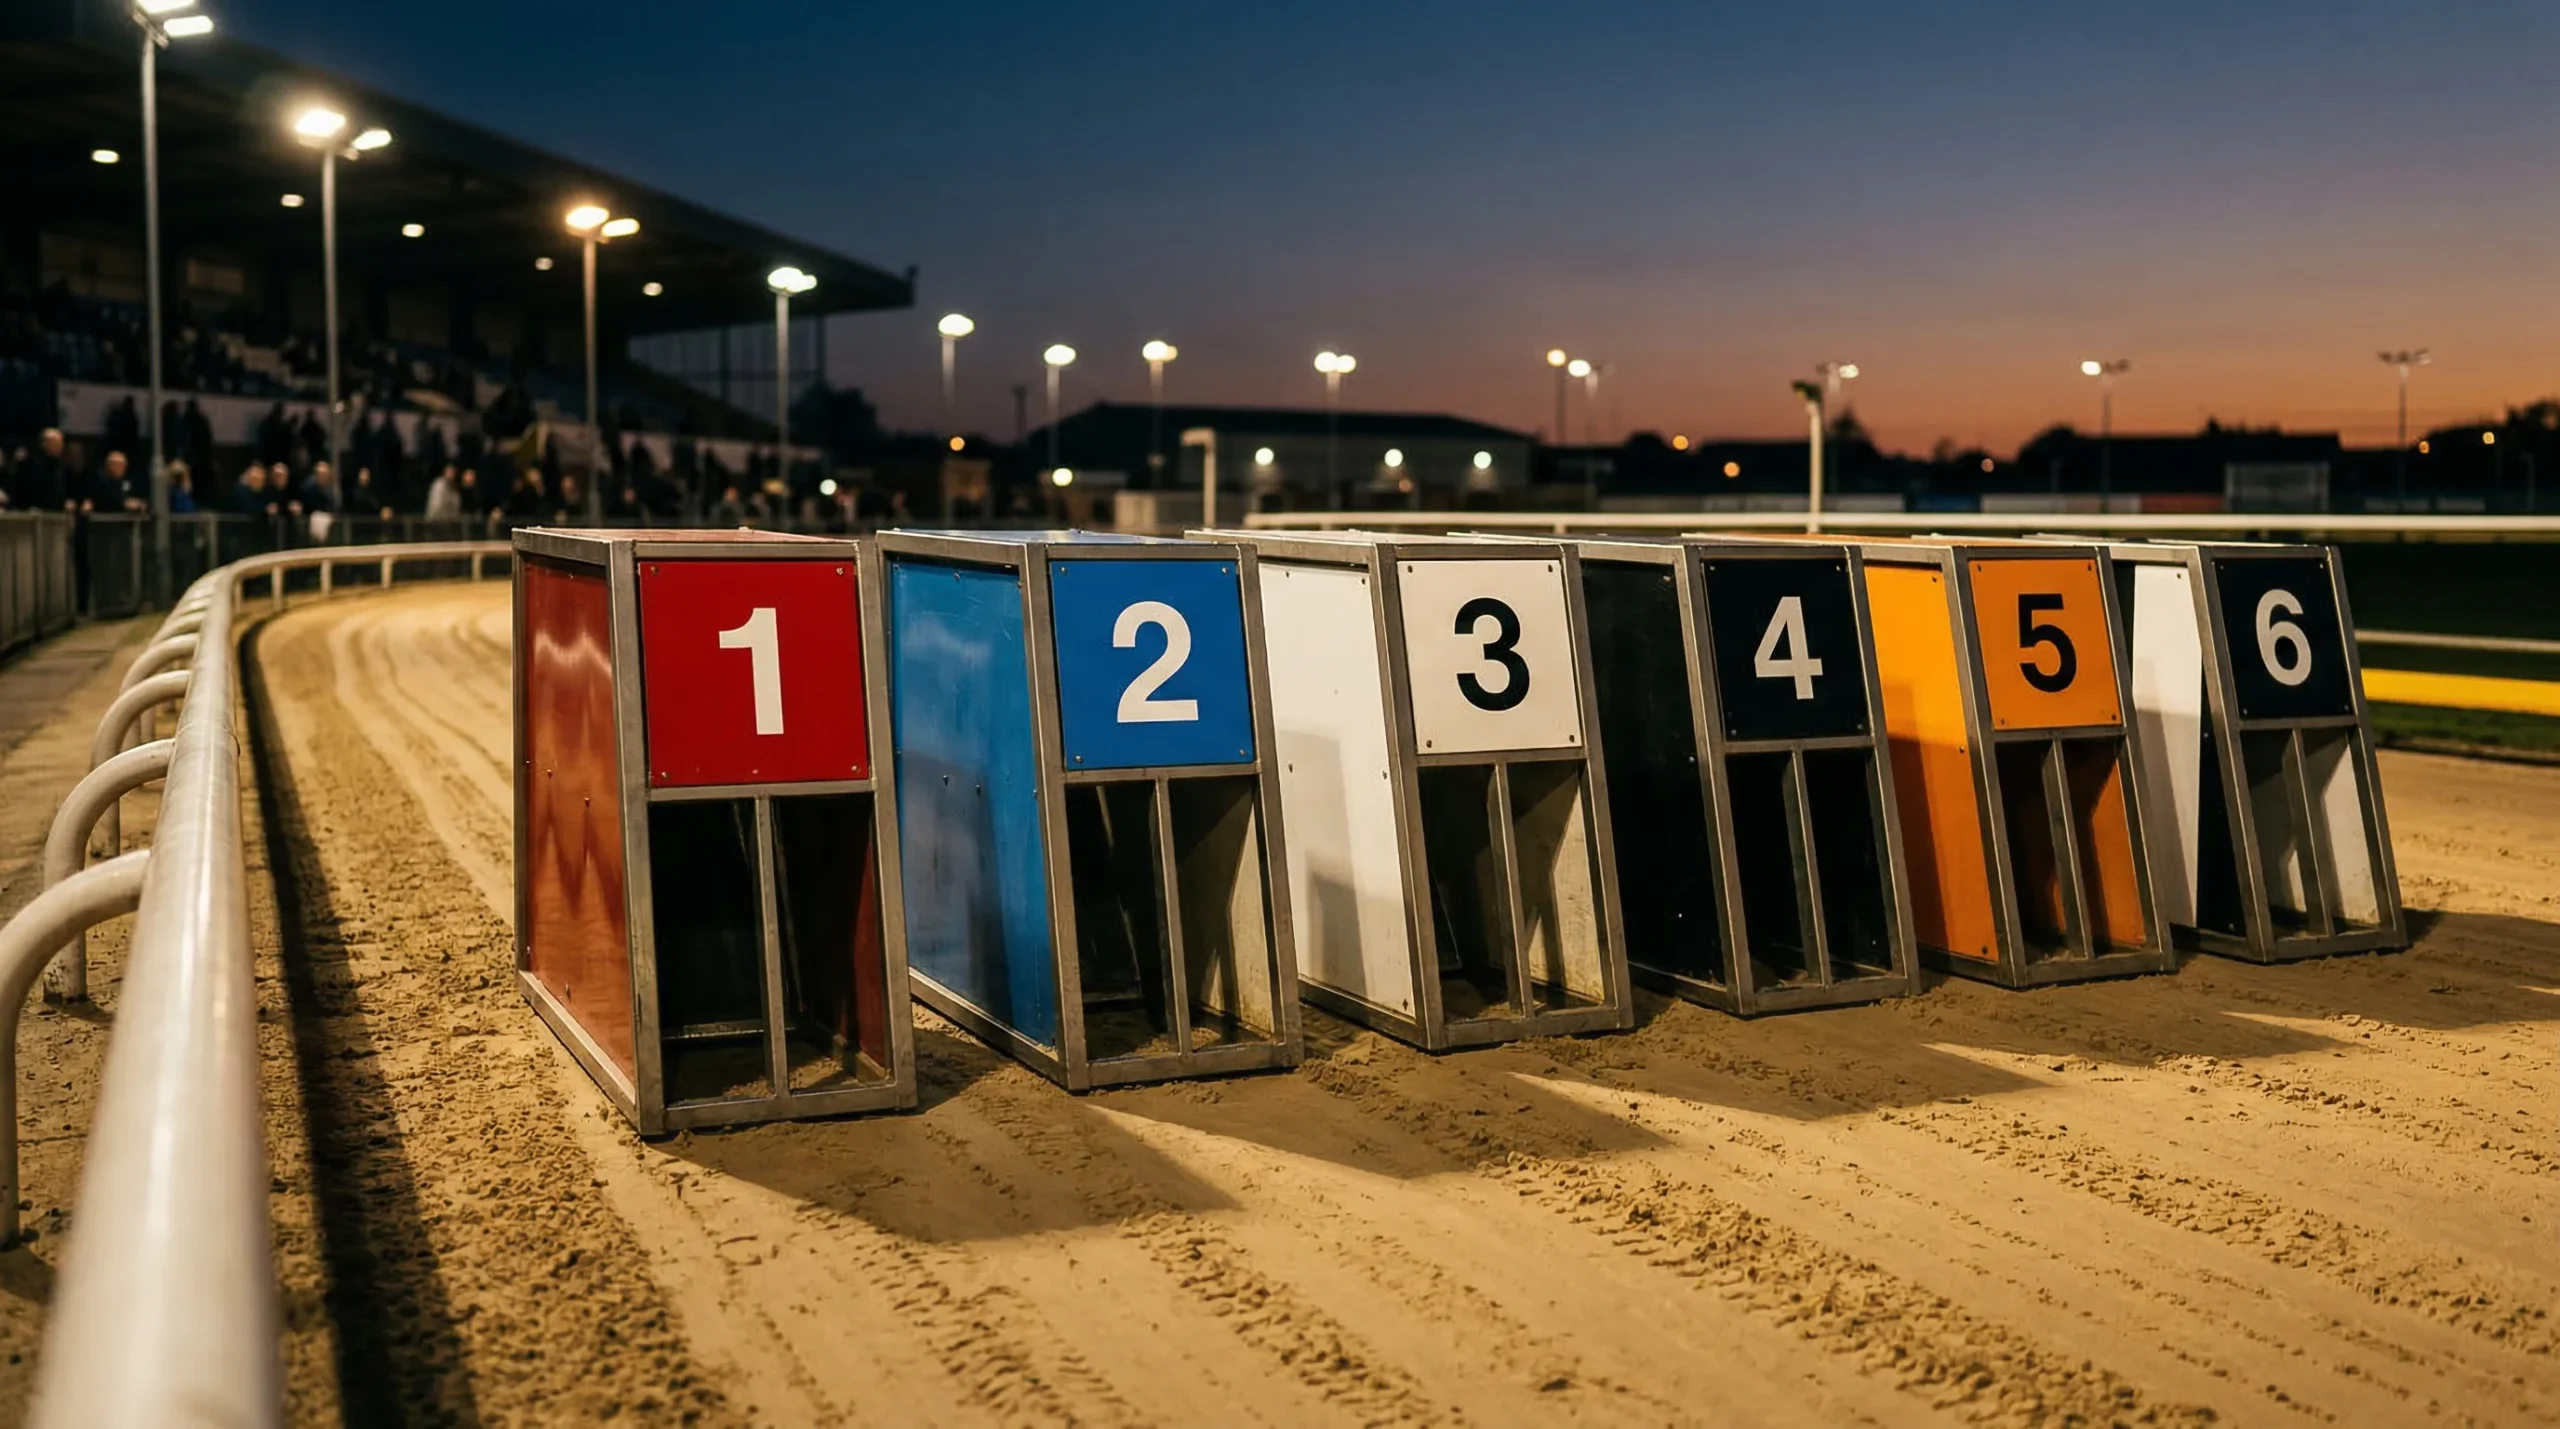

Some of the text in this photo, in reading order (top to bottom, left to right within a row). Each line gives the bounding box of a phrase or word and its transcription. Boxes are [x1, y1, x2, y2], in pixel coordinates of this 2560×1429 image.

[719, 608, 785, 734] 1
[1113, 601, 1198, 722] 2
[1454, 598, 1530, 711] 3
[1754, 597, 1823, 699] 4
[2019, 594, 2076, 692] 5
[2255, 589, 2311, 685] 6
